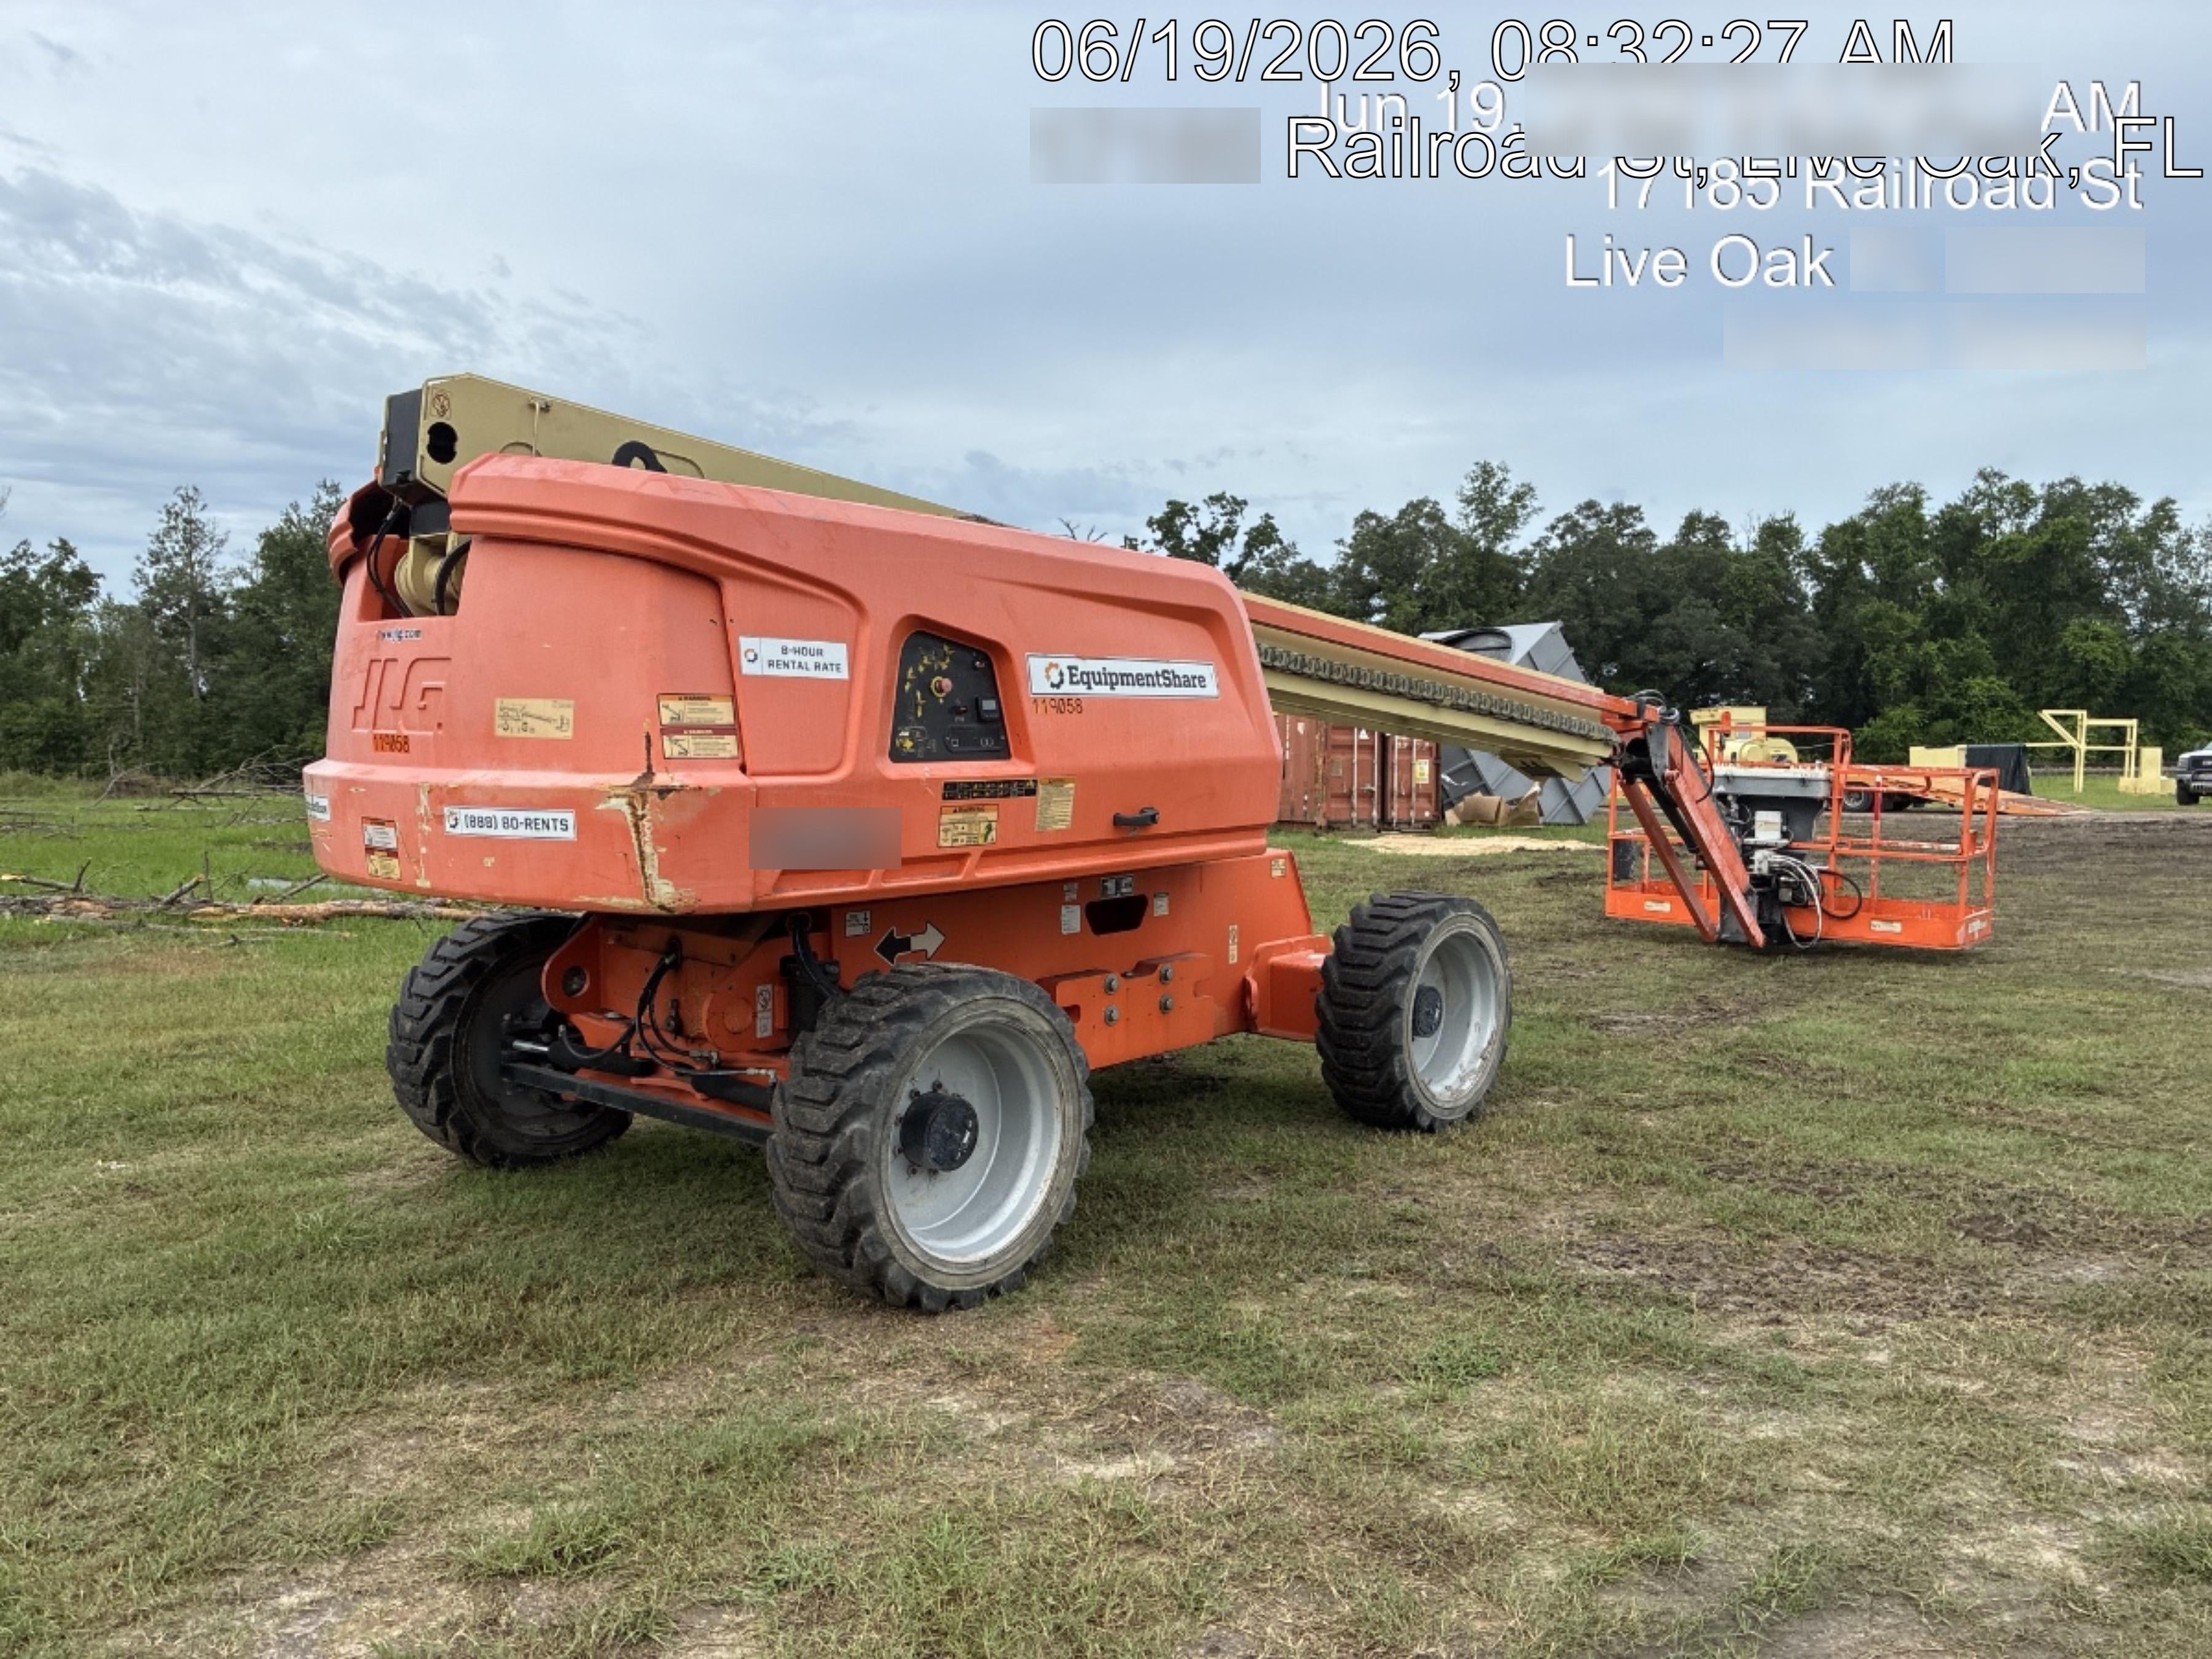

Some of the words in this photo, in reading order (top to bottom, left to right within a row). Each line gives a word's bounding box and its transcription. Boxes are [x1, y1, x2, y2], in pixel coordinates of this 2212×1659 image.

[767, 659, 810, 672] RENTAL
[814, 662, 842, 673] RATE
[1067, 664, 1207, 691] EquipmentShare
[1032, 698, 1083, 714] 119058
